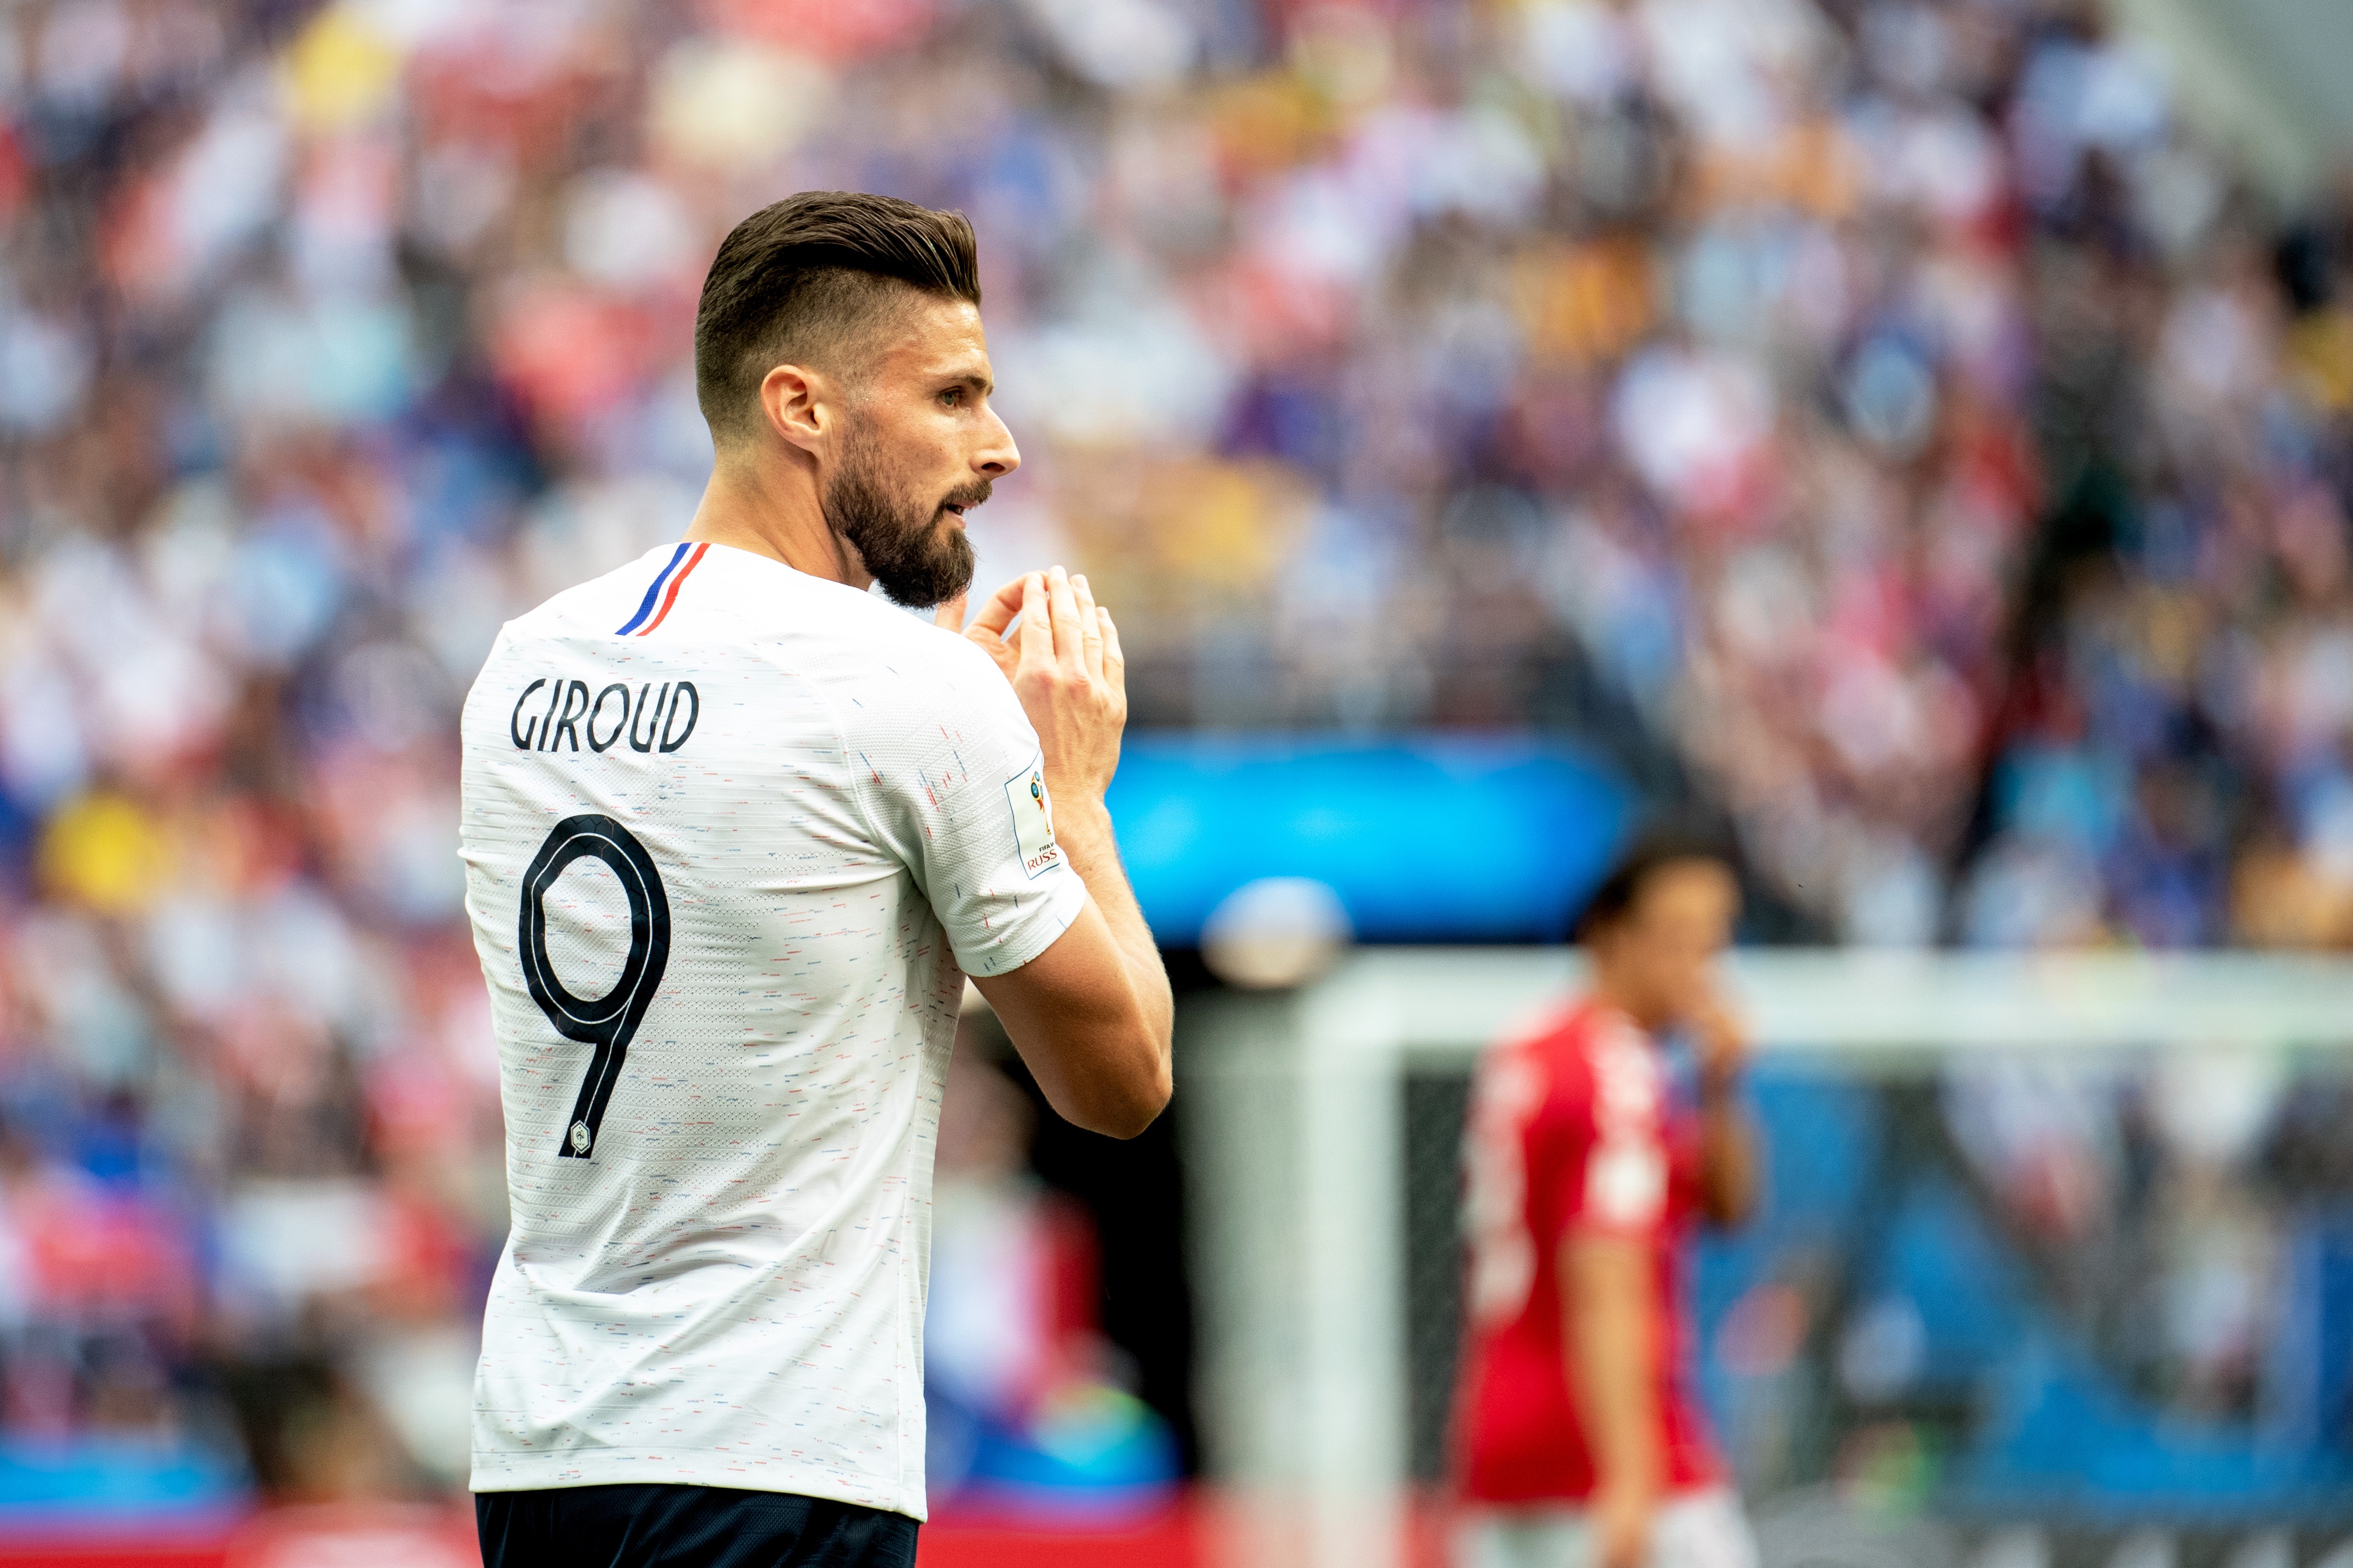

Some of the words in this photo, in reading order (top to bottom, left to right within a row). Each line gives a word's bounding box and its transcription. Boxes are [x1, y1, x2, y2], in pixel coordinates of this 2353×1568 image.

[511, 678, 699, 753] GIROUD
[1039, 844, 1050, 852] FIFA
[519, 814, 671, 1159] 9
